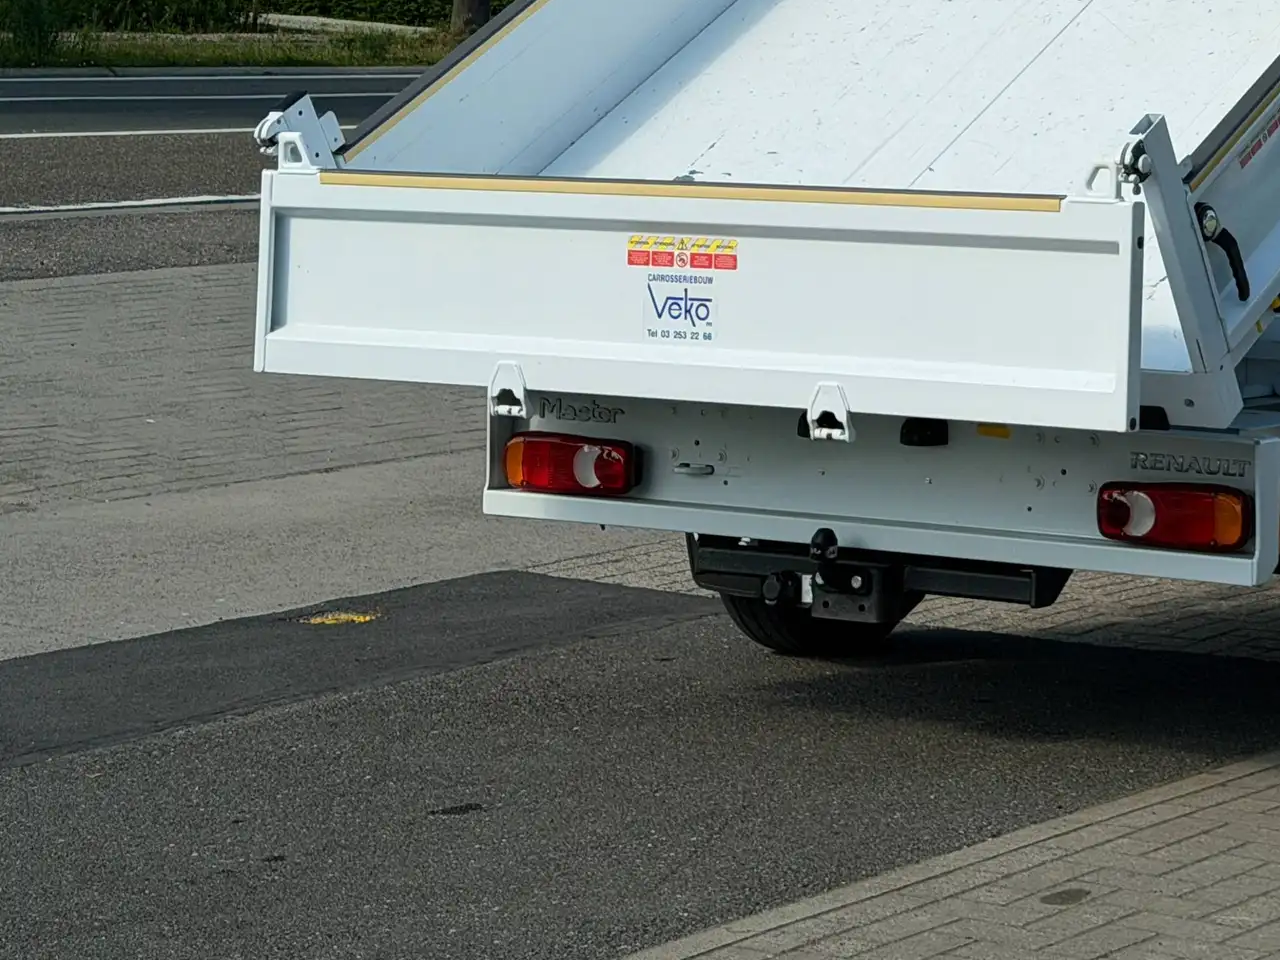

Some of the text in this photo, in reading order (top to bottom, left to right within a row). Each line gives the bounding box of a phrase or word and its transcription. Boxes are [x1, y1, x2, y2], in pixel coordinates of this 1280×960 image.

[647, 273, 714, 285] CARROSSERIEBOUW
[647, 283, 713, 327] Veko
[647, 329, 658, 338] Tel
[660, 330, 670, 338] 03
[673, 331, 687, 339] 253
[690, 332, 700, 340] 22
[539, 396, 626, 424] Master
[1130, 451, 1252, 477] RENAULT
